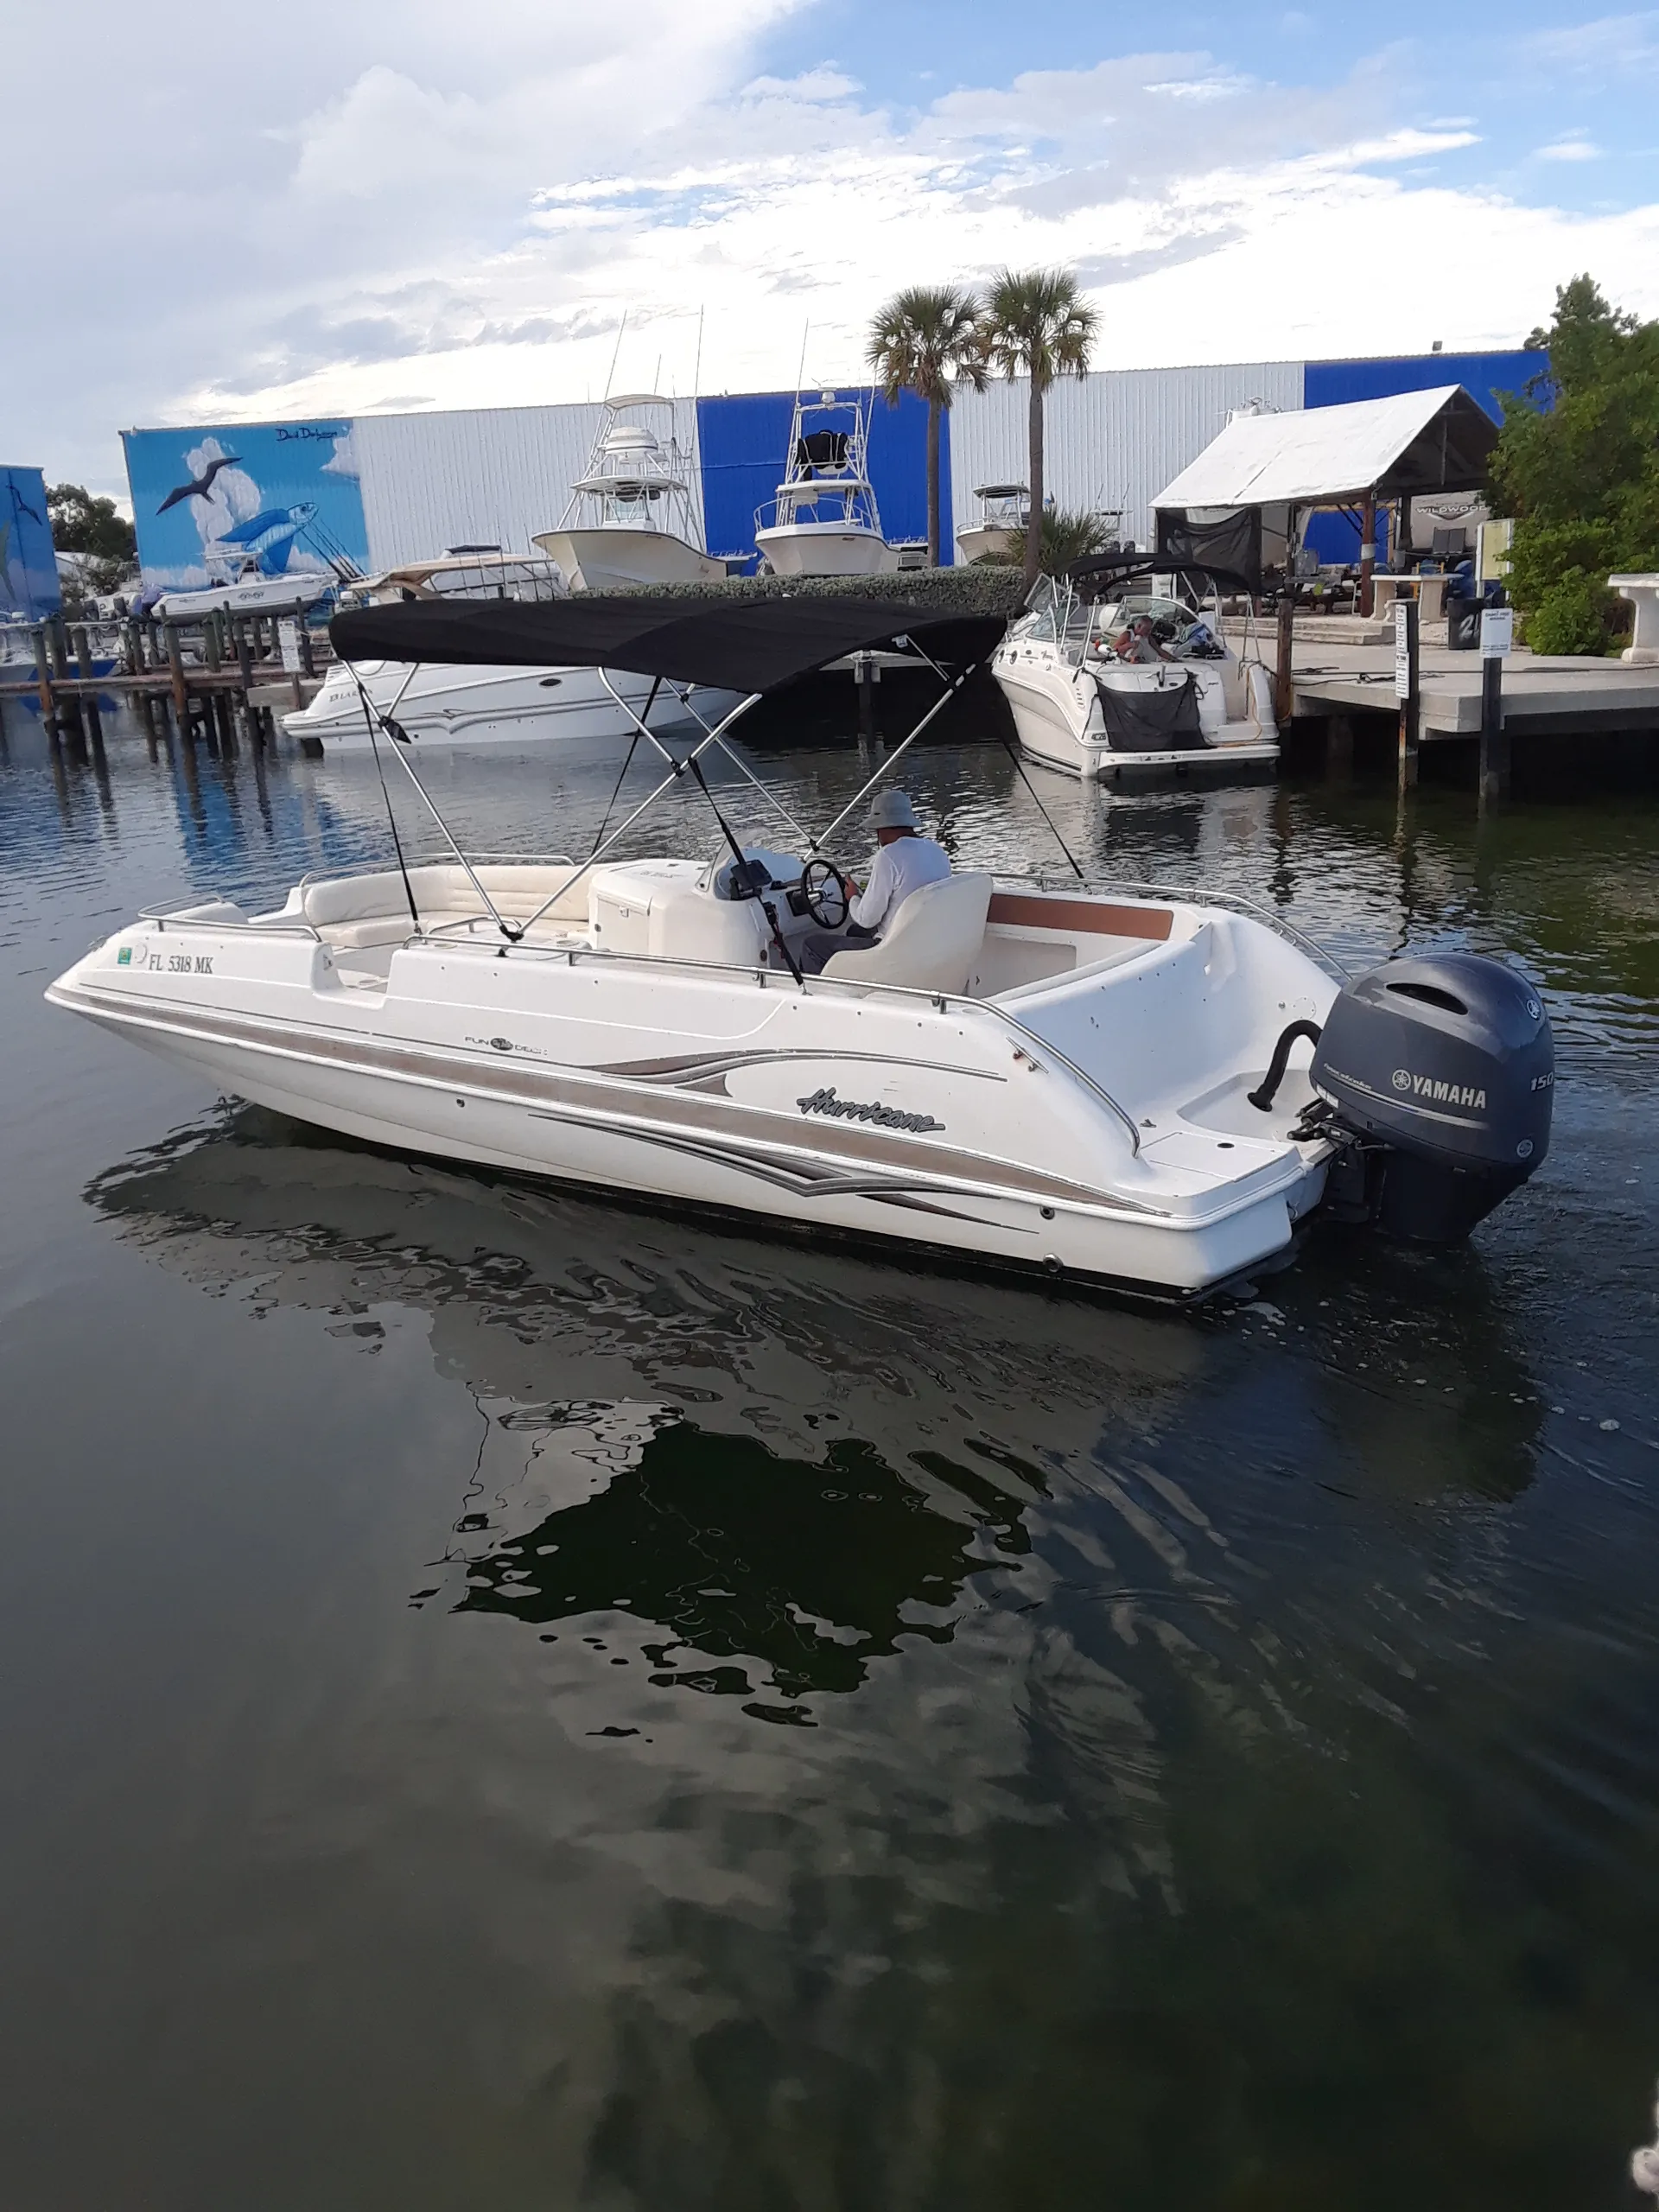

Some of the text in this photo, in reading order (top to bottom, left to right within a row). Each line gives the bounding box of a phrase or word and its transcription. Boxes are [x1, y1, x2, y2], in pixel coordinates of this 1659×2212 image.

[340, 689, 373, 700] LARN
[149, 954, 213, 974] FL 5318 MK
[465, 1036, 489, 1046] FUN
[1530, 1071, 1554, 1091] 150
[1413, 1074, 1486, 1109] YAMAHA
[797, 1087, 945, 1132] Hurricane
